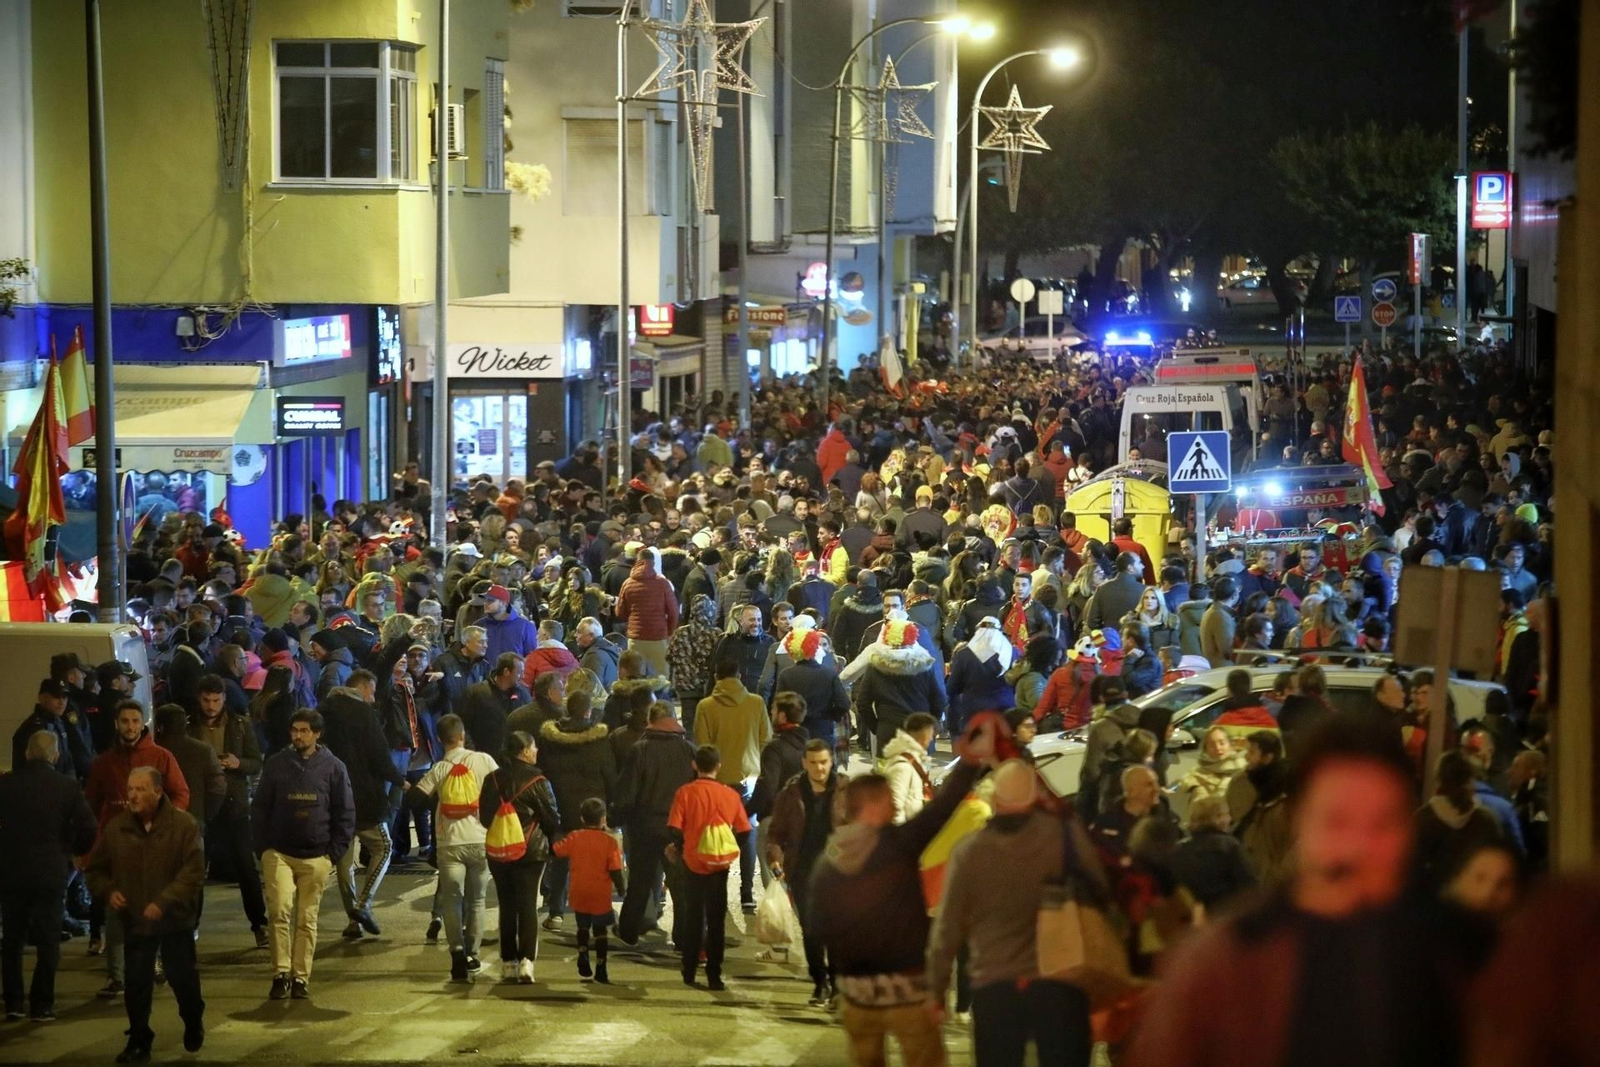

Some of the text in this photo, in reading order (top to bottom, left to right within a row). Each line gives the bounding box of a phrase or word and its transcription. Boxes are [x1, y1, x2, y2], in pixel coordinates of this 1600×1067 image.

[1481, 177, 1502, 201] P
[1375, 310, 1394, 318] STOP
[458, 346, 553, 374] Wicket
[1136, 393, 1214, 405] Cruz Roja Española
[173, 447, 222, 459] Cruzcampo
[1271, 492, 1338, 506] ESPAÑA
